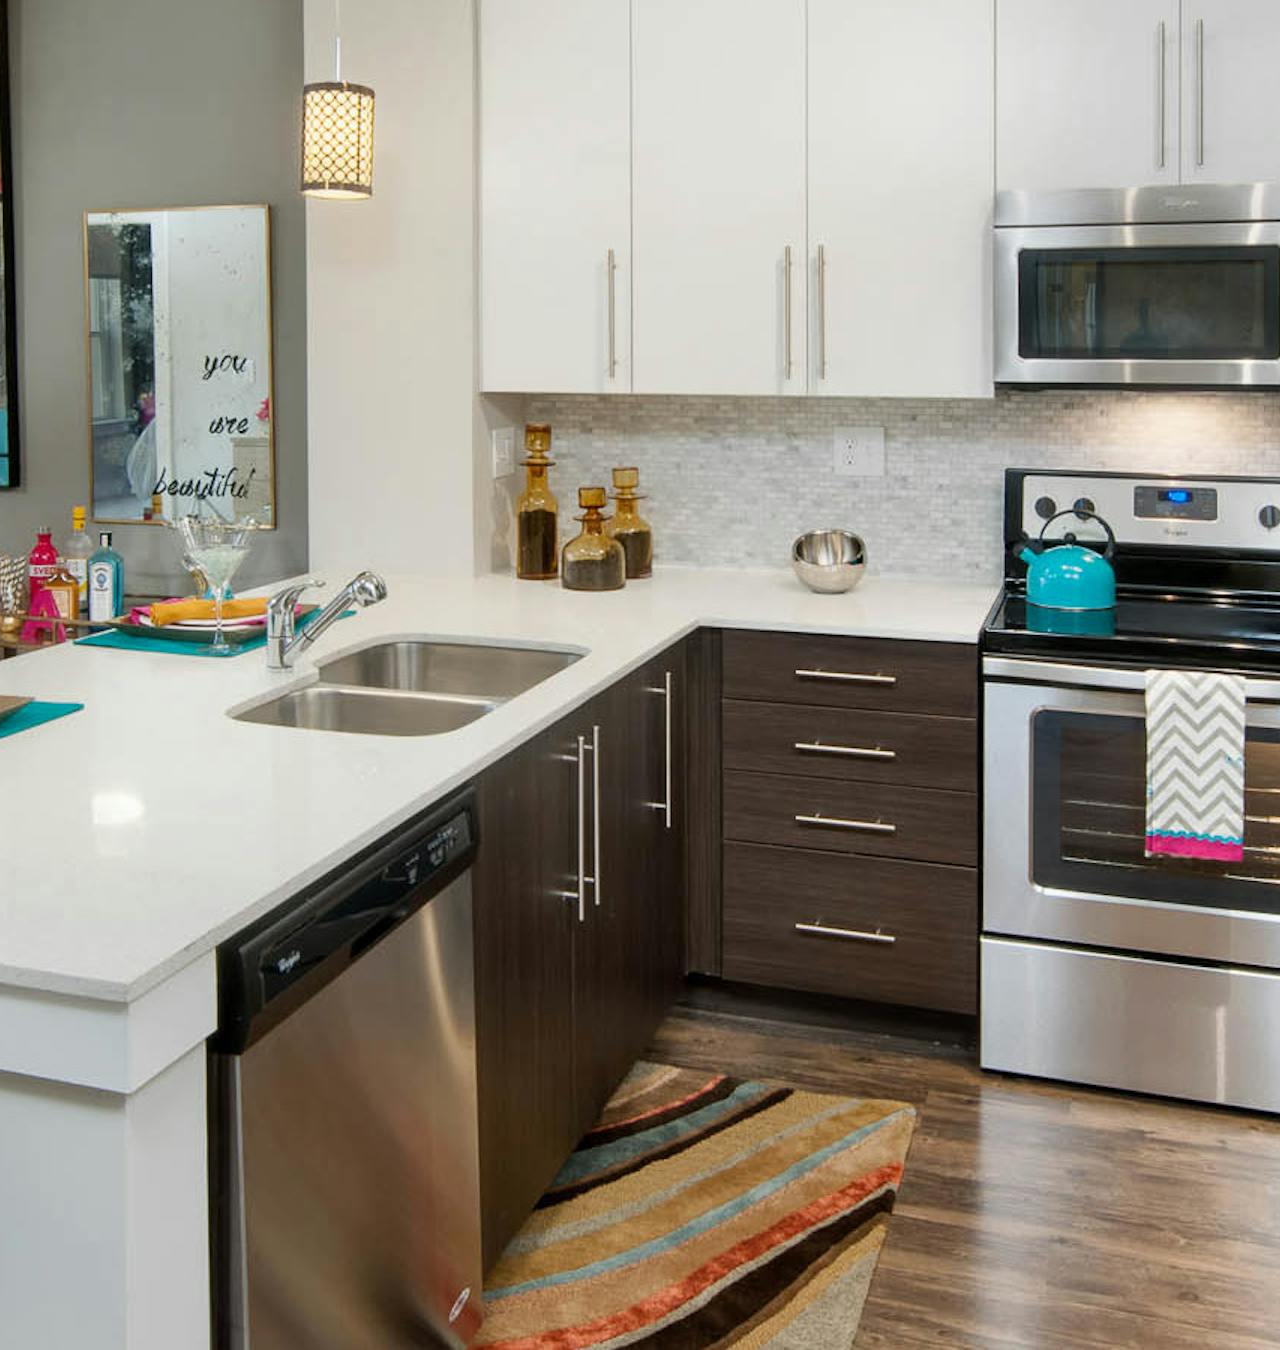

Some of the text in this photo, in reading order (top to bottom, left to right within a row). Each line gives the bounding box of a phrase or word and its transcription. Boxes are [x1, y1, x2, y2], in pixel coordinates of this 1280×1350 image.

[202, 355, 247, 380] you
[209, 416, 250, 434] are
[152, 466, 256, 500] beautiful
